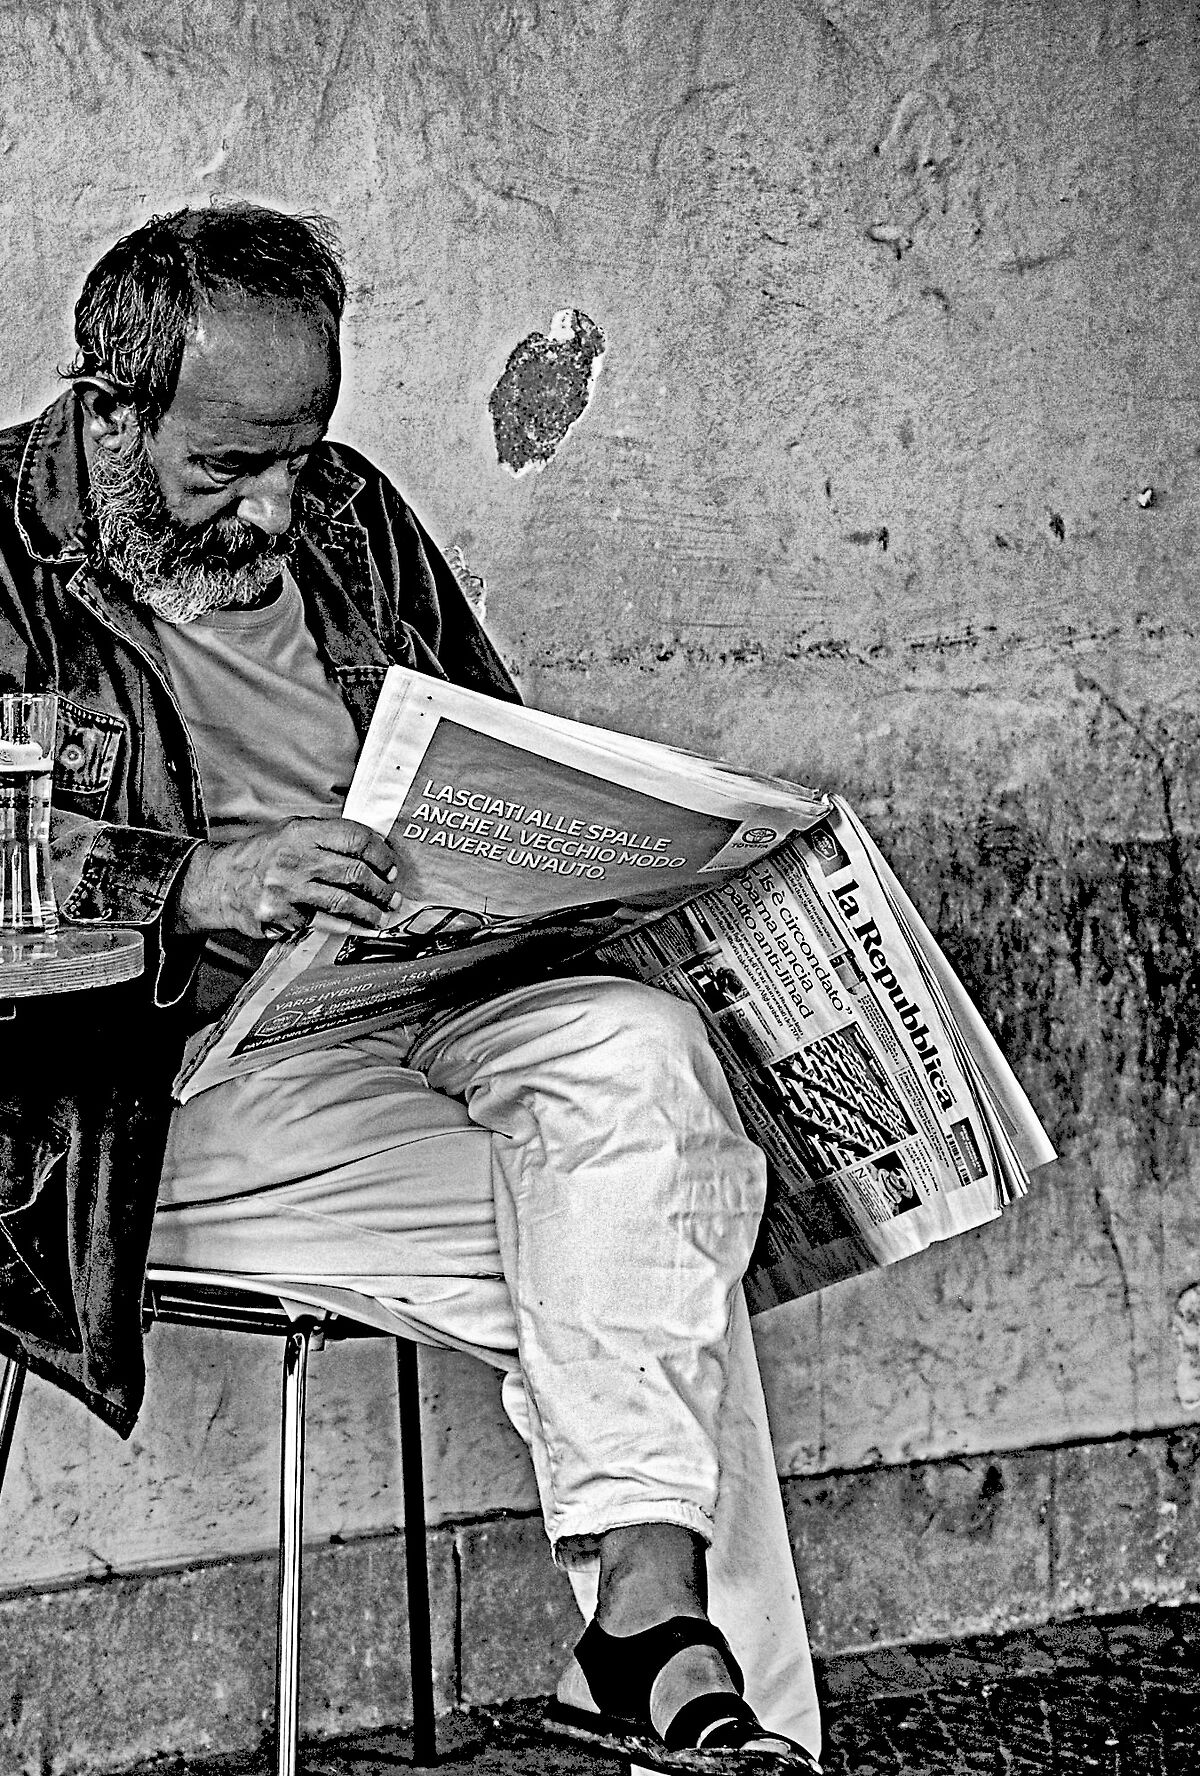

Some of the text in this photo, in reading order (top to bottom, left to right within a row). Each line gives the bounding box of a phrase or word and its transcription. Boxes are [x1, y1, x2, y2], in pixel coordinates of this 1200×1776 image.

[402, 822, 604, 879] DI AVERE UN'AUTO.
[410, 801, 686, 867] ANCHE IL VECCHIO MODO
[422, 778, 671, 859] LASCIATI ALLE SPALLE
[717, 883, 757, 930] patto
[752, 930, 814, 1019] anti-Jihad
[775, 932, 814, 993] lancia
[276, 994, 318, 1011] YARIS
[317, 982, 373, 1001] HYBRID
[832, 878, 860, 920] la
[855, 917, 955, 1113] Repubblica
